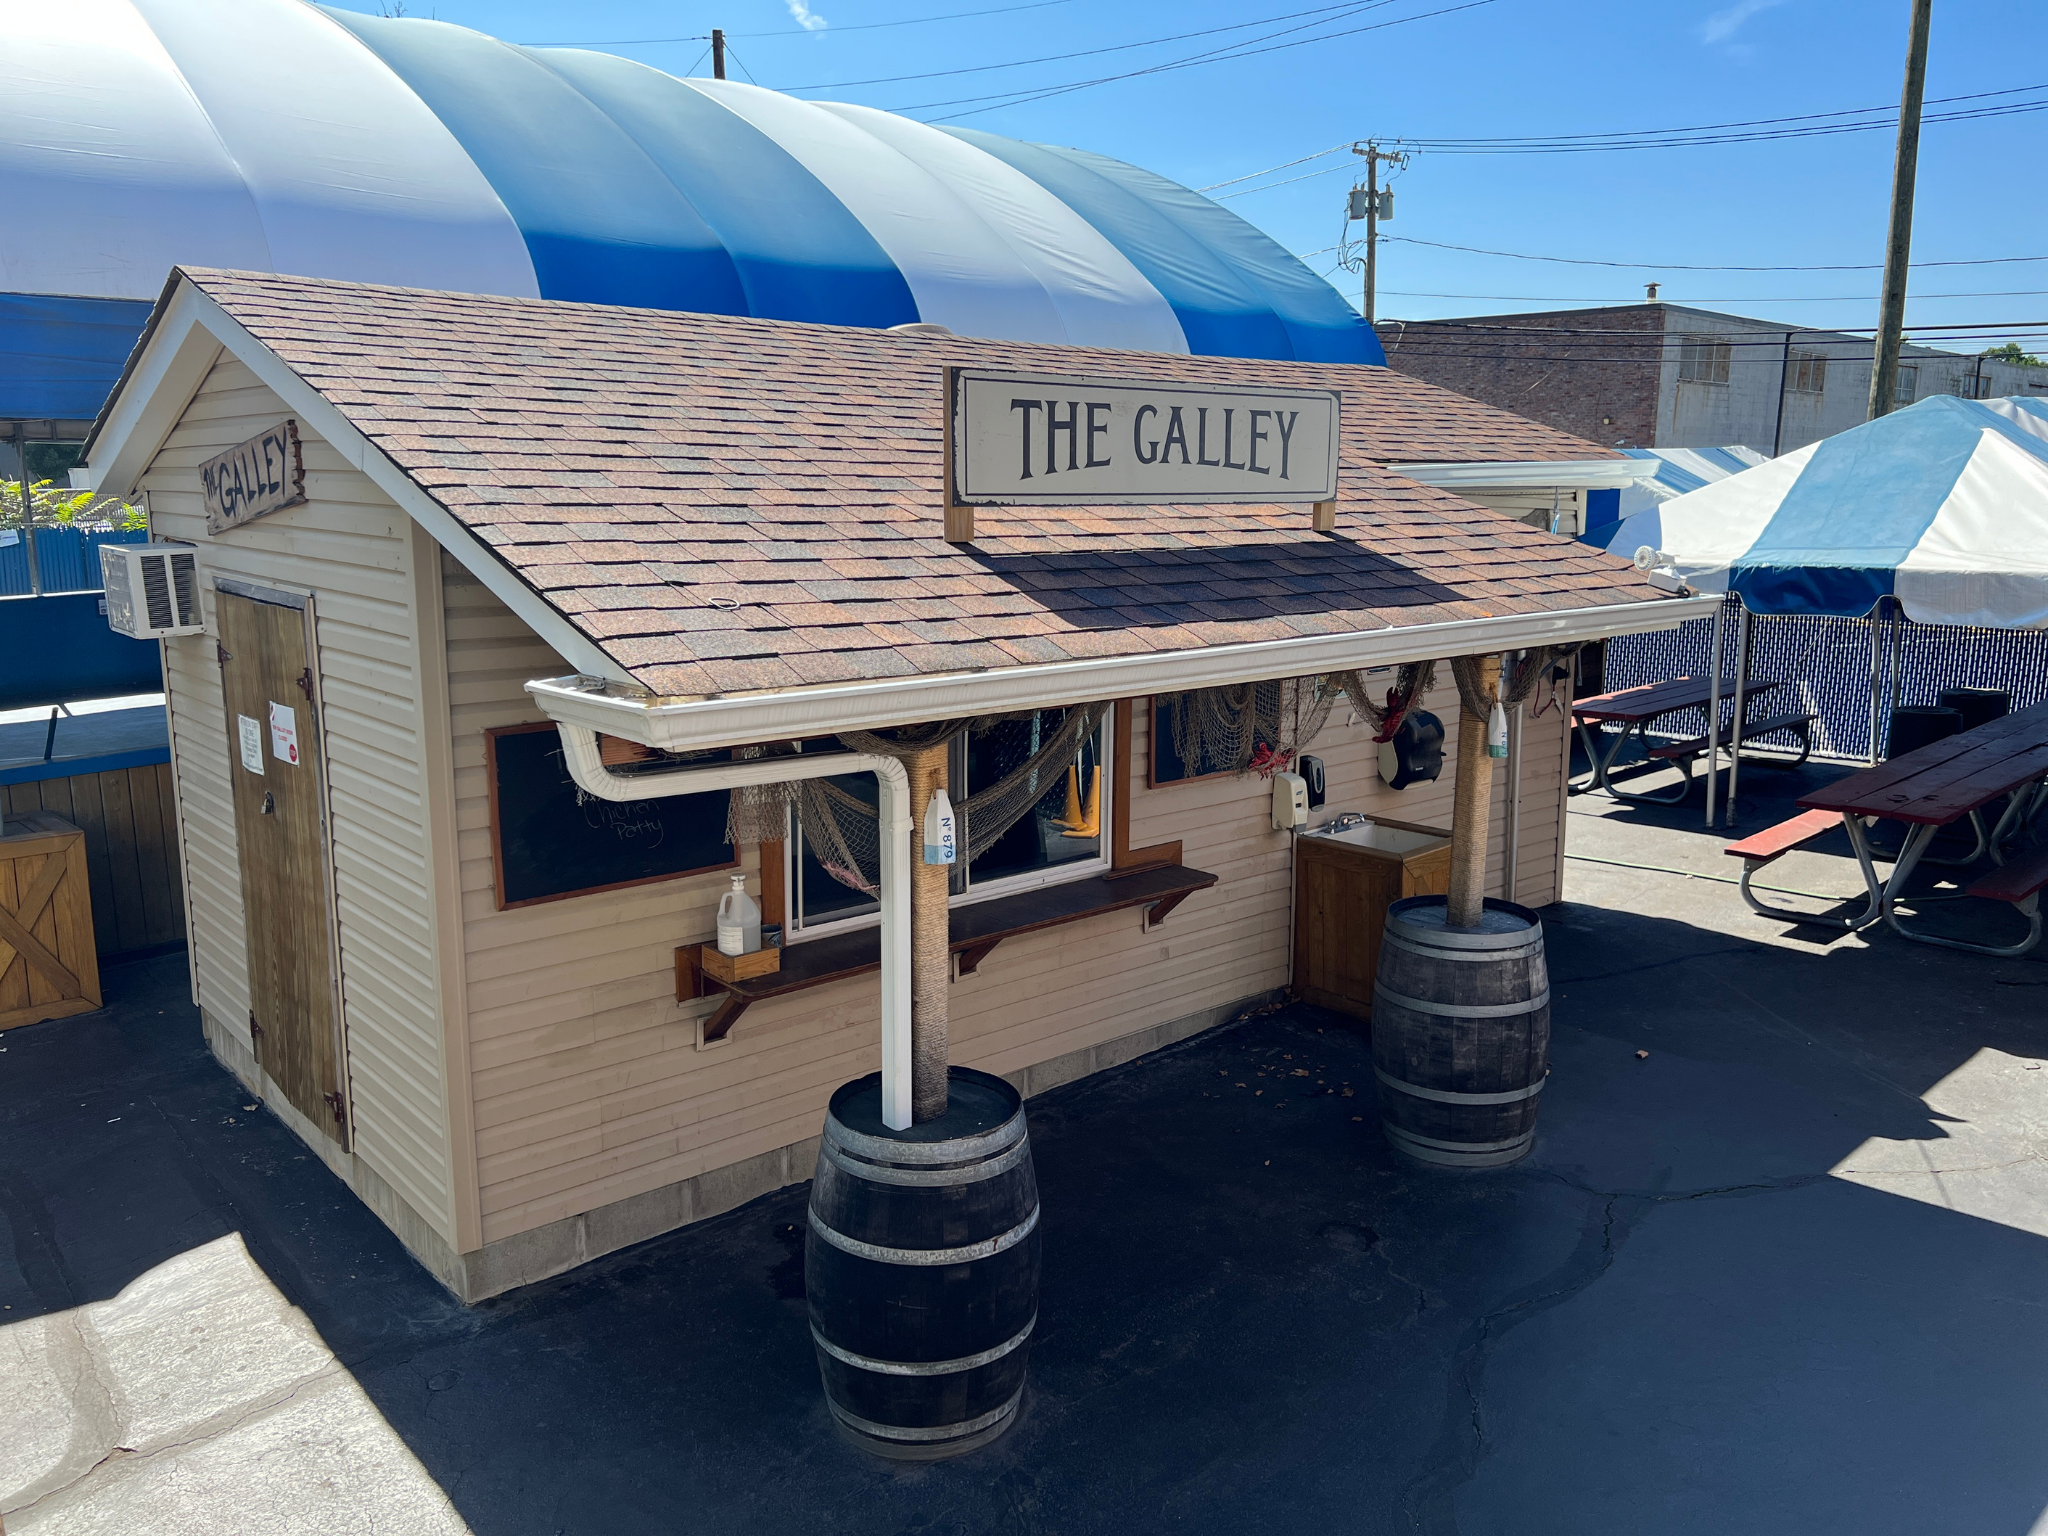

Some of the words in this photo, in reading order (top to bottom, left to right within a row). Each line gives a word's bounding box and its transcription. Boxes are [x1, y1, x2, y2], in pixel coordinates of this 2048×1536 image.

[203, 461, 220, 501] THE
[219, 426, 287, 518] GALLEY
[1010, 398, 1112, 481] THE
[1133, 403, 1300, 481] GALLEY
[943, 834, 953, 859] 879
